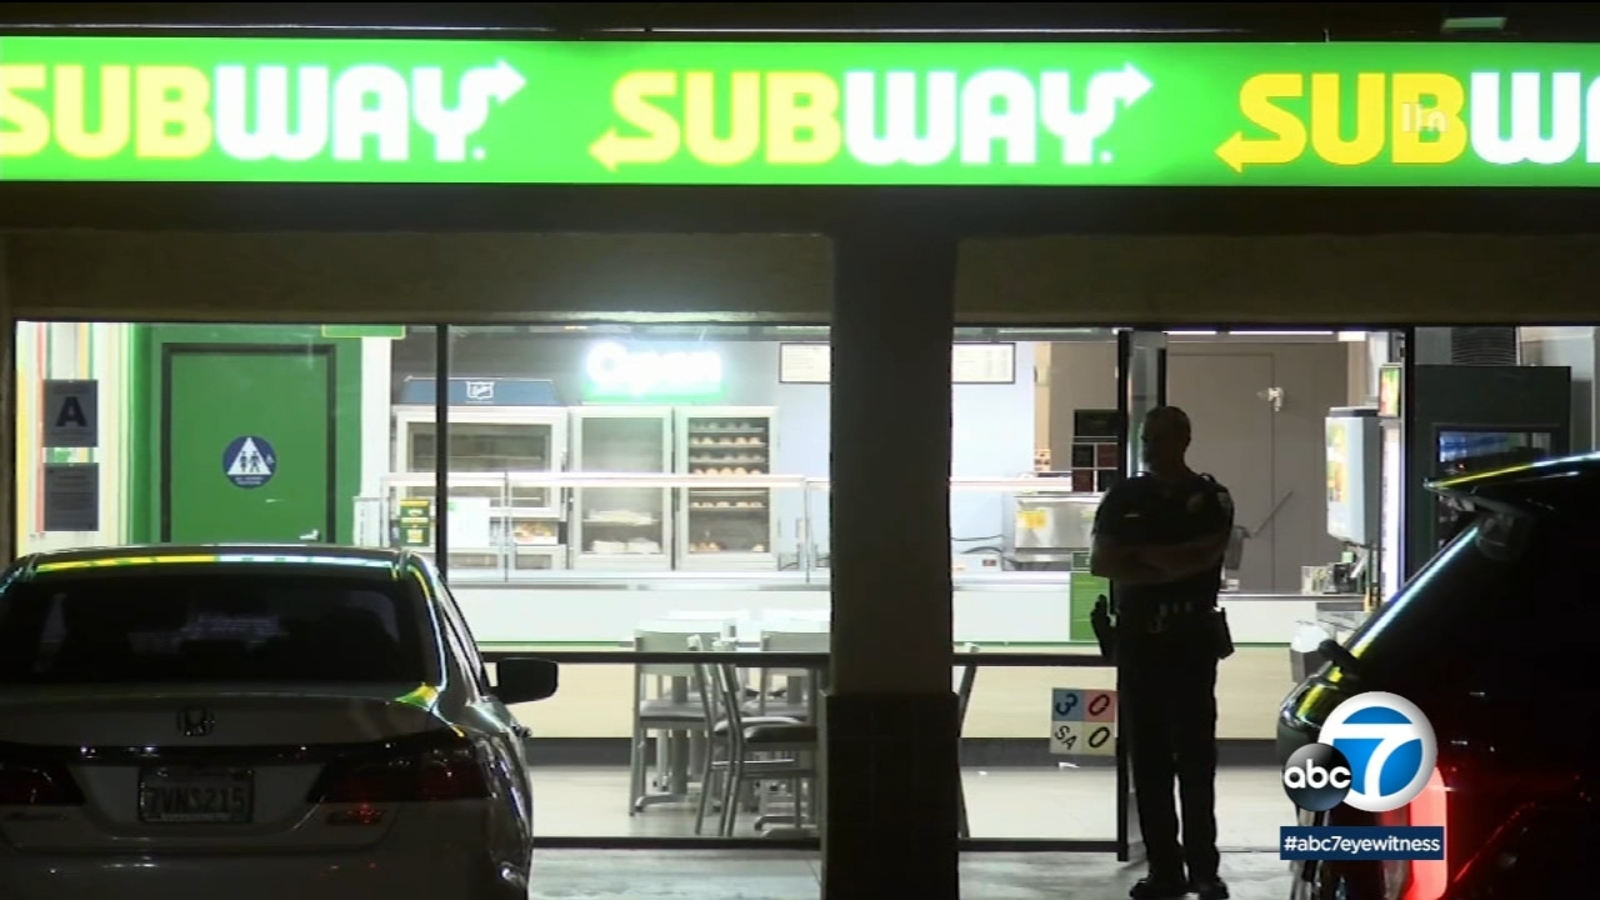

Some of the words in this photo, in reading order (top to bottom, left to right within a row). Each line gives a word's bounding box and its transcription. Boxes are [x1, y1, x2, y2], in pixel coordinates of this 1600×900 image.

[0, 58, 527, 162] SUBWAY
[589, 62, 1153, 171] SUBWAY
[1214, 72, 1600, 173] SUBW
[55, 396, 88, 427] A
[1054, 725, 1077, 750] SA
[1055, 693, 1078, 716] 3
